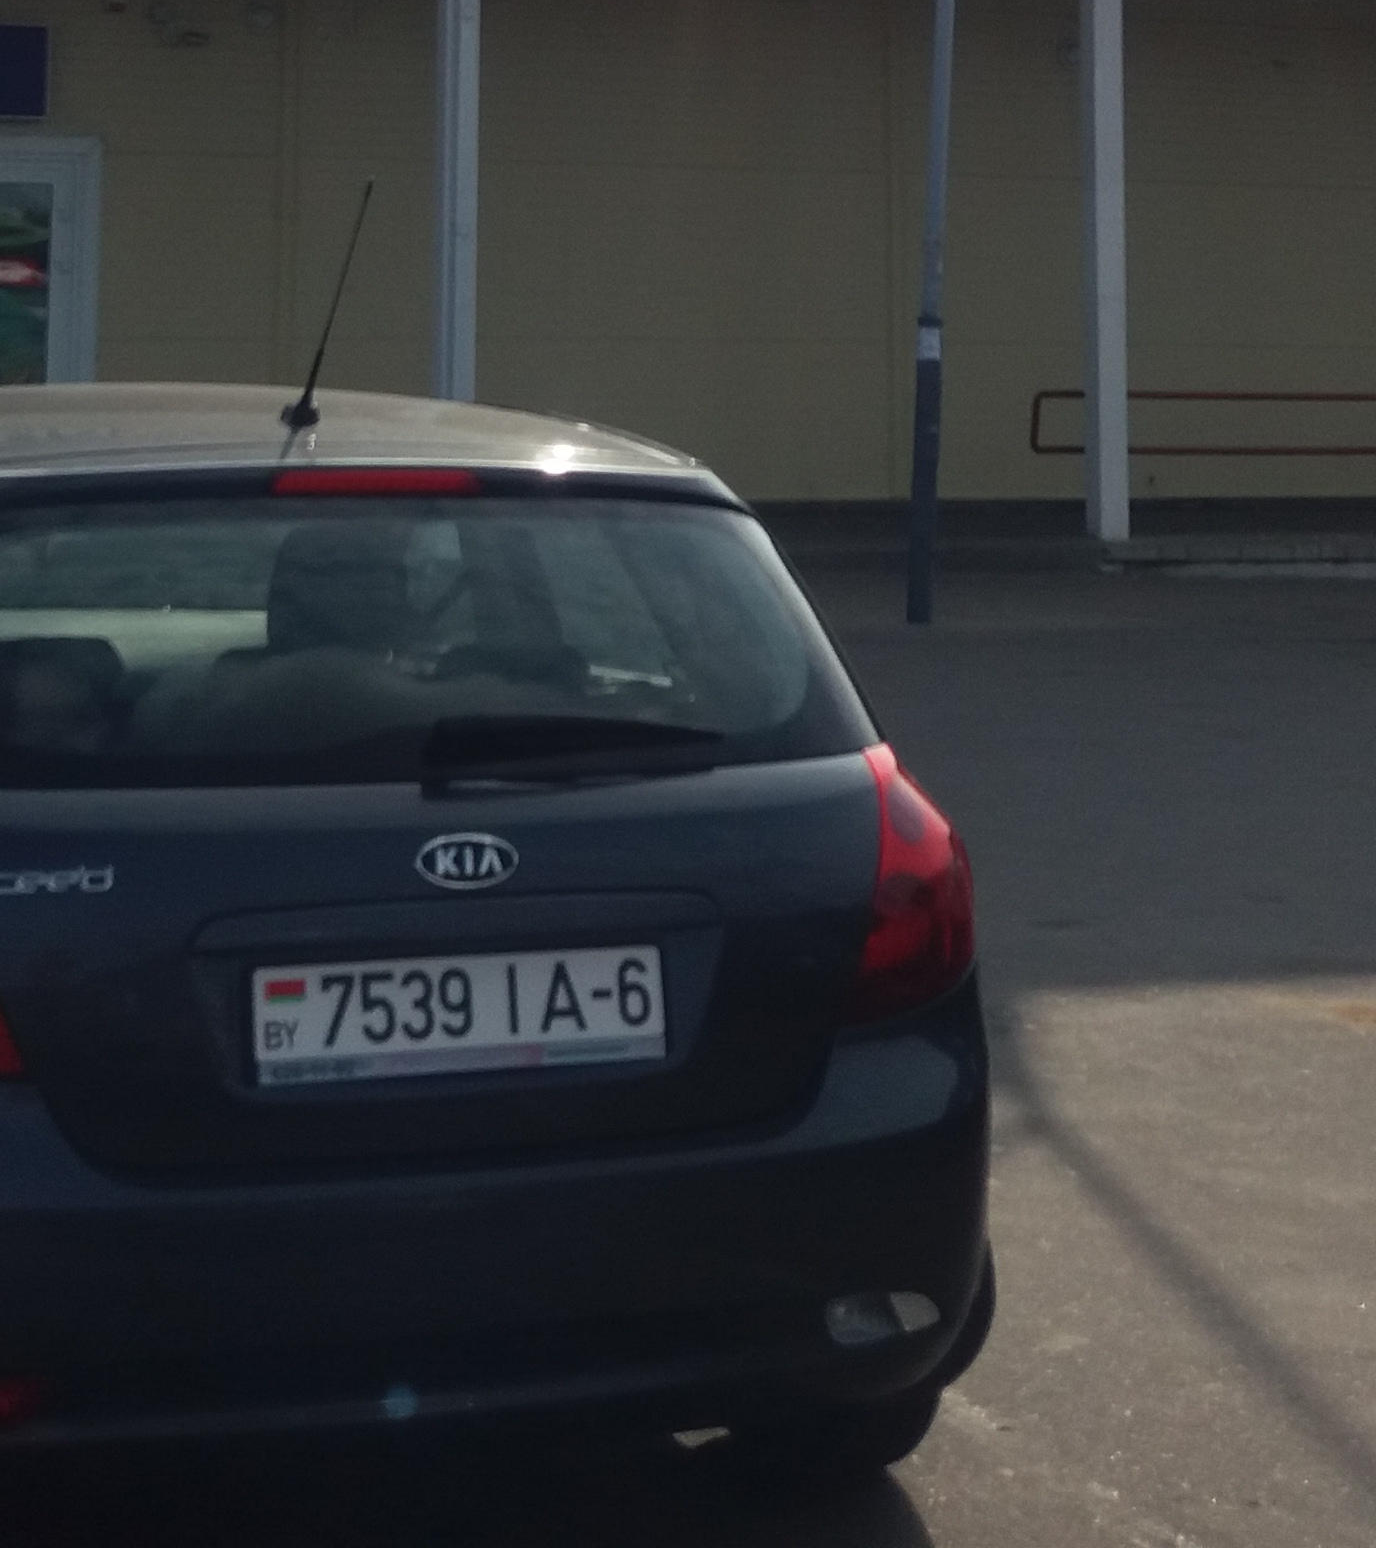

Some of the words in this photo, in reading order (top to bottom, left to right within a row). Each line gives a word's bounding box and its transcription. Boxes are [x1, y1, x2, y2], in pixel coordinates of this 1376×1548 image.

[435, 846, 504, 877] KIA
[320, 967, 475, 1049] 7539
[263, 1019, 300, 1051] BY
